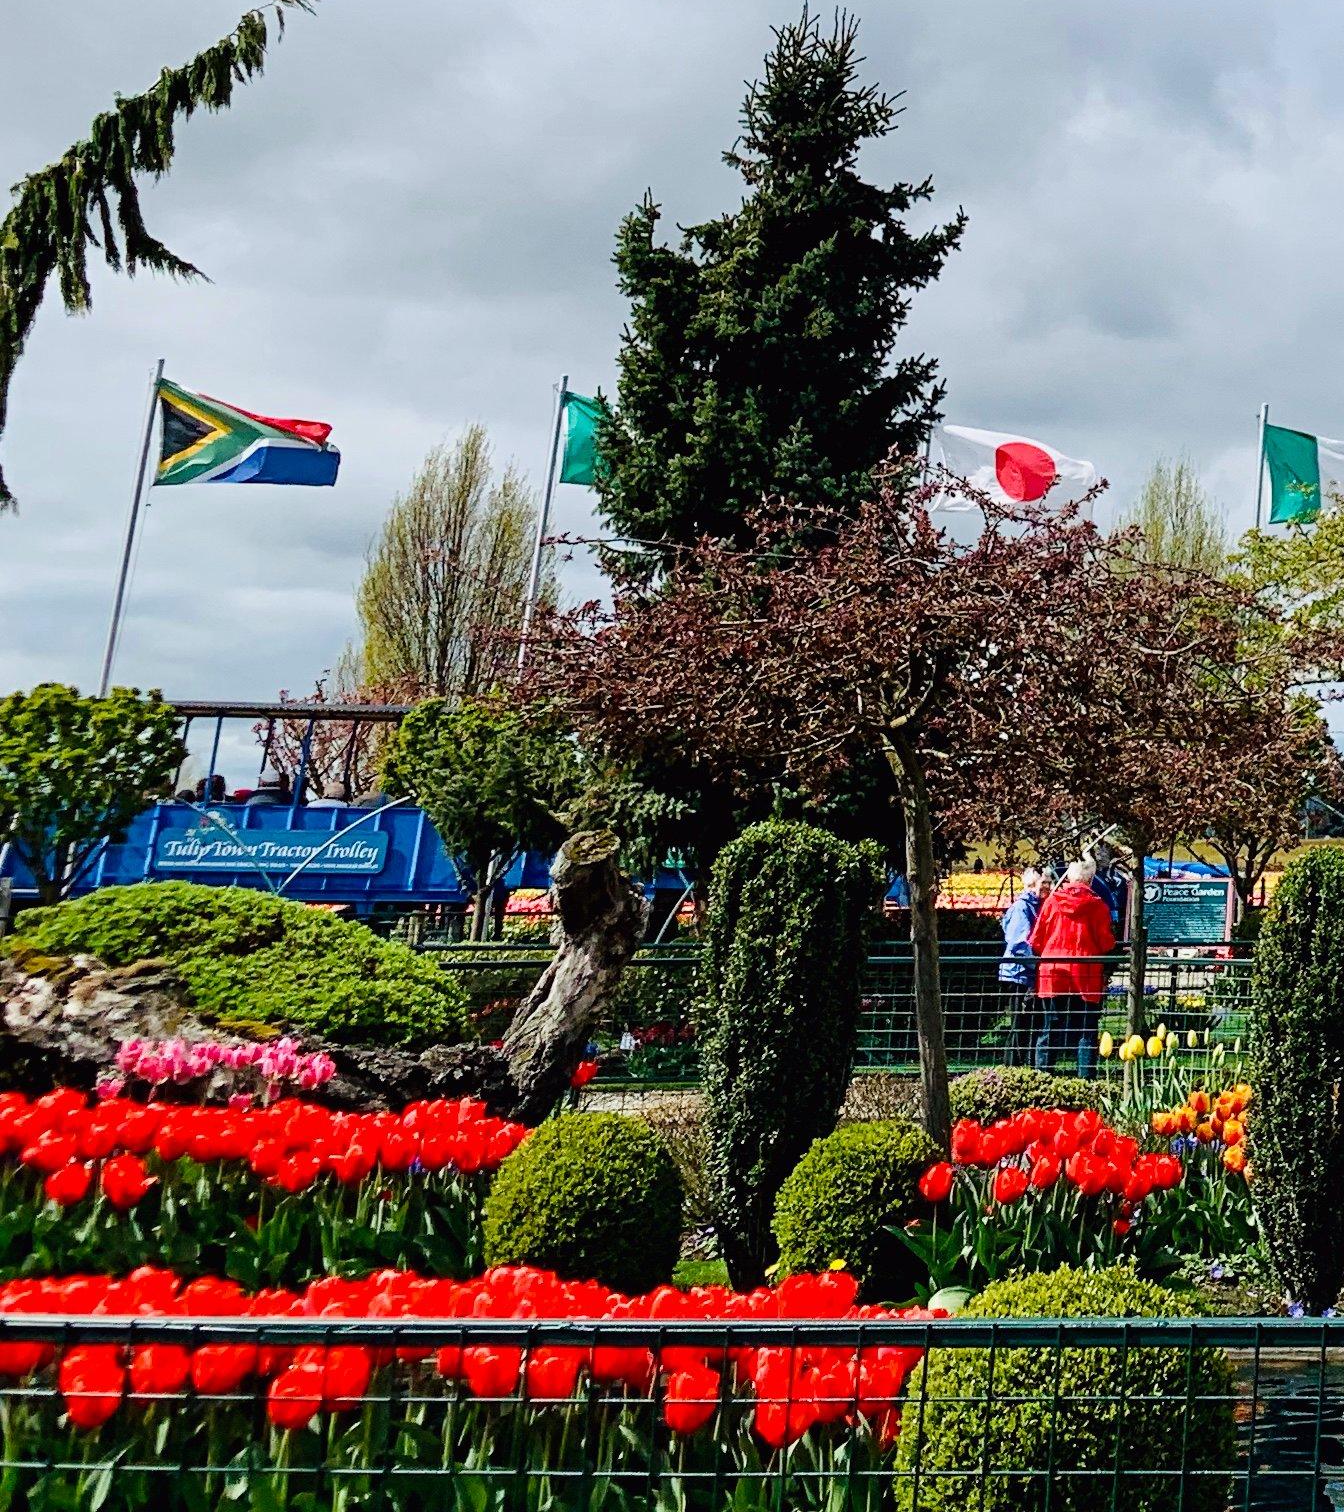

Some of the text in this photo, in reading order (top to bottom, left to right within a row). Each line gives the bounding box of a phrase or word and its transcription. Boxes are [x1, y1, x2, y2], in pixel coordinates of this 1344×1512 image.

[163, 838, 212, 863] Tulip
[258, 841, 321, 859] Tractor
[324, 841, 378, 864] Trolley
[1163, 888, 1225, 896] Peace Garden
